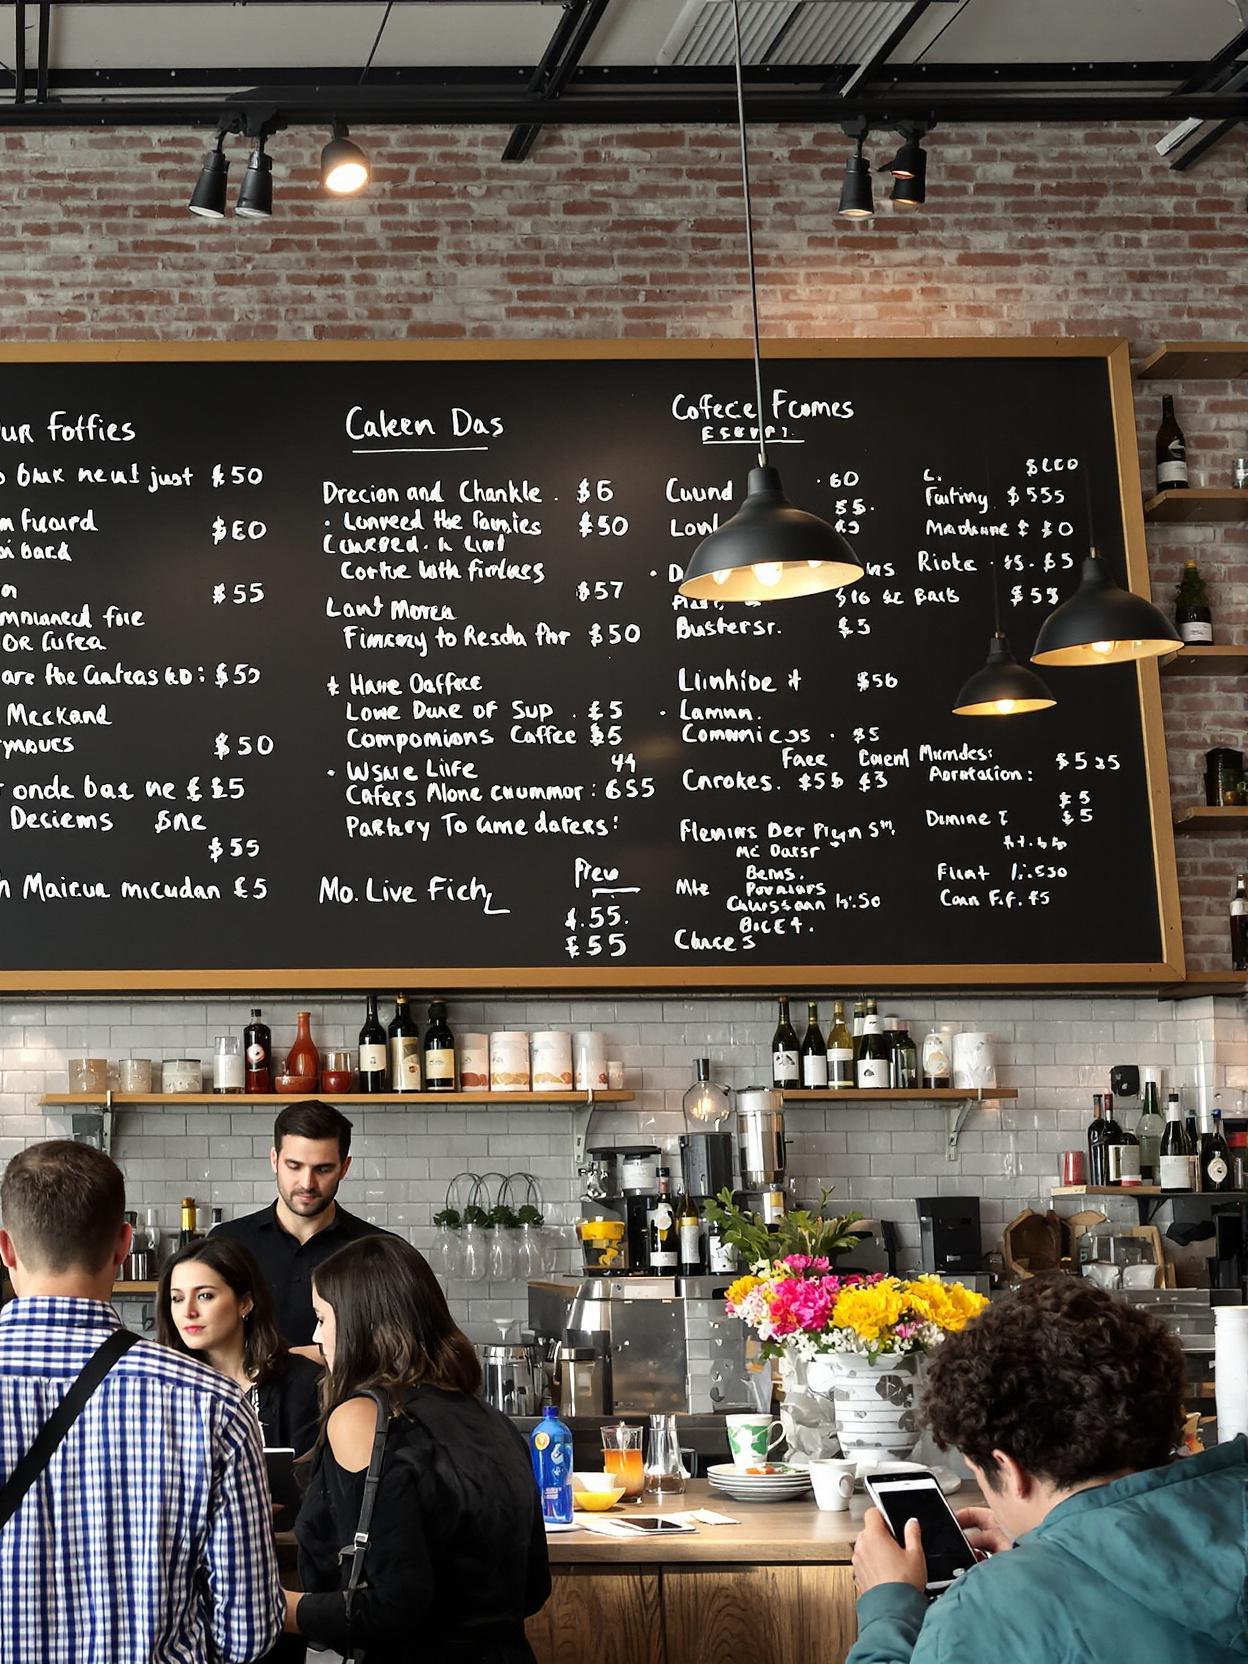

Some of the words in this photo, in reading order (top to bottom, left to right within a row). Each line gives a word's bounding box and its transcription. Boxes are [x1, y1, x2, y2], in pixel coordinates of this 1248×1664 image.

[451, 407, 504, 438] Das
[147, 465, 194, 494] just
[406, 480, 445, 503] and
[434, 626, 458, 648] to
[213, 731, 274, 761] $50
[440, 812, 468, 837] To
[767, 821, 806, 839] Der
[366, 877, 418, 903] Live
